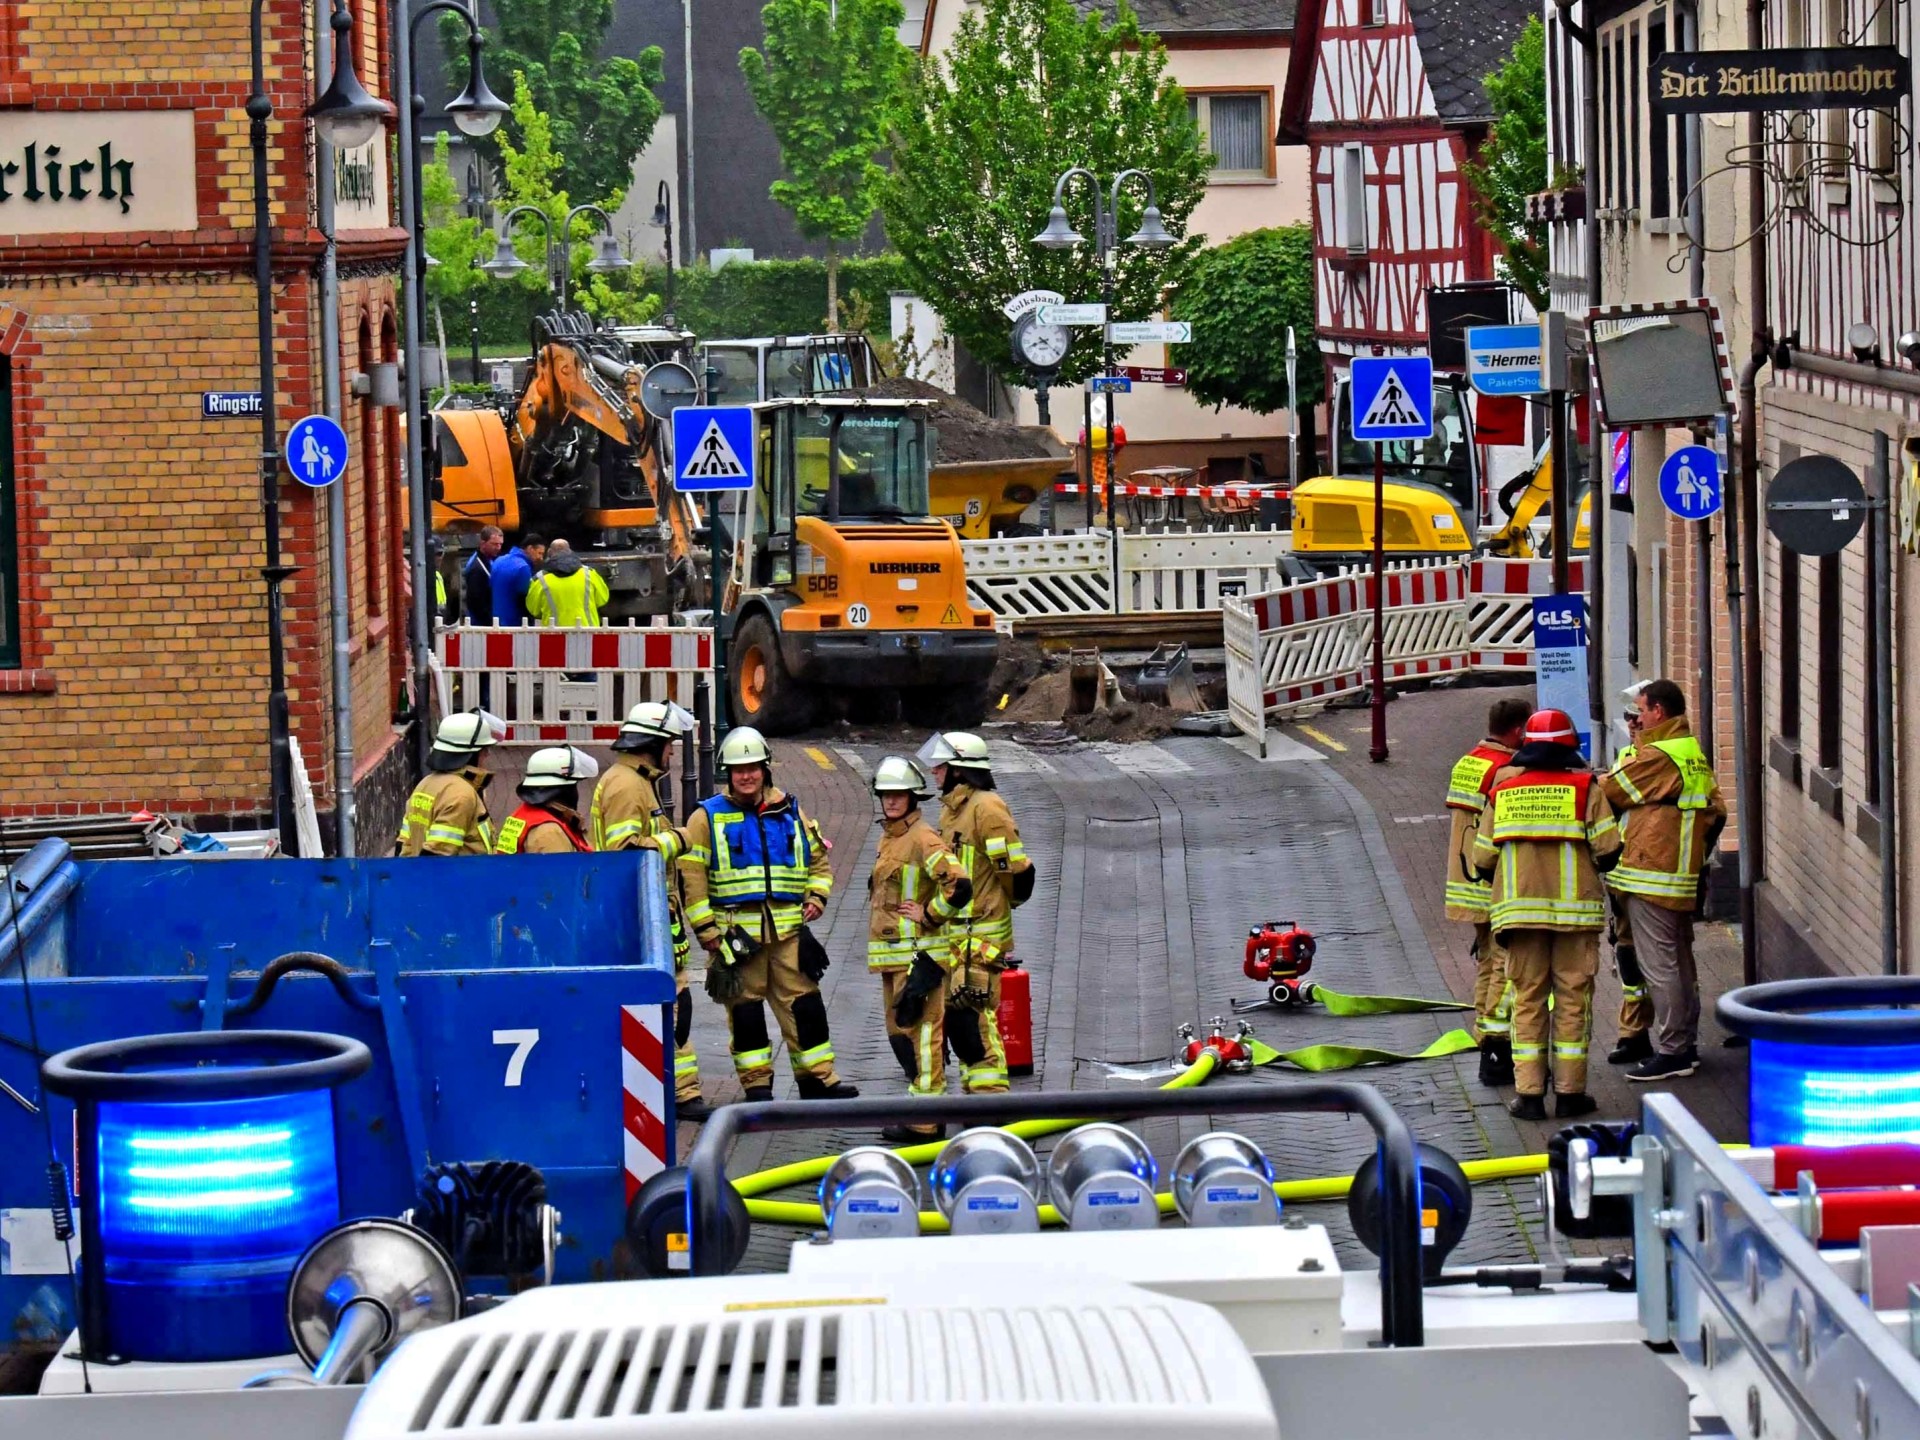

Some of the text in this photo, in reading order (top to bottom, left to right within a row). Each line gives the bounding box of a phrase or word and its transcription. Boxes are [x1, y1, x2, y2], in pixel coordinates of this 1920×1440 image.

[1660, 64, 1897, 98] Der Brillenmacher
[1008, 294, 1062, 314] Volksbank
[1488, 377, 1538, 387] PaketSho
[209, 394, 263, 414] Ringstr.
[968, 501, 979, 514] 25
[869, 562, 942, 574] LIEBHERR
[808, 575, 838, 592] 506
[851, 607, 867, 623] 20
[1537, 610, 1573, 626] GLS
[744, 744, 750, 754] A
[1500, 787, 1570, 798] FEUERWEHR
[1507, 804, 1562, 813] Wehrführer
[493, 1028, 540, 1087] 7
